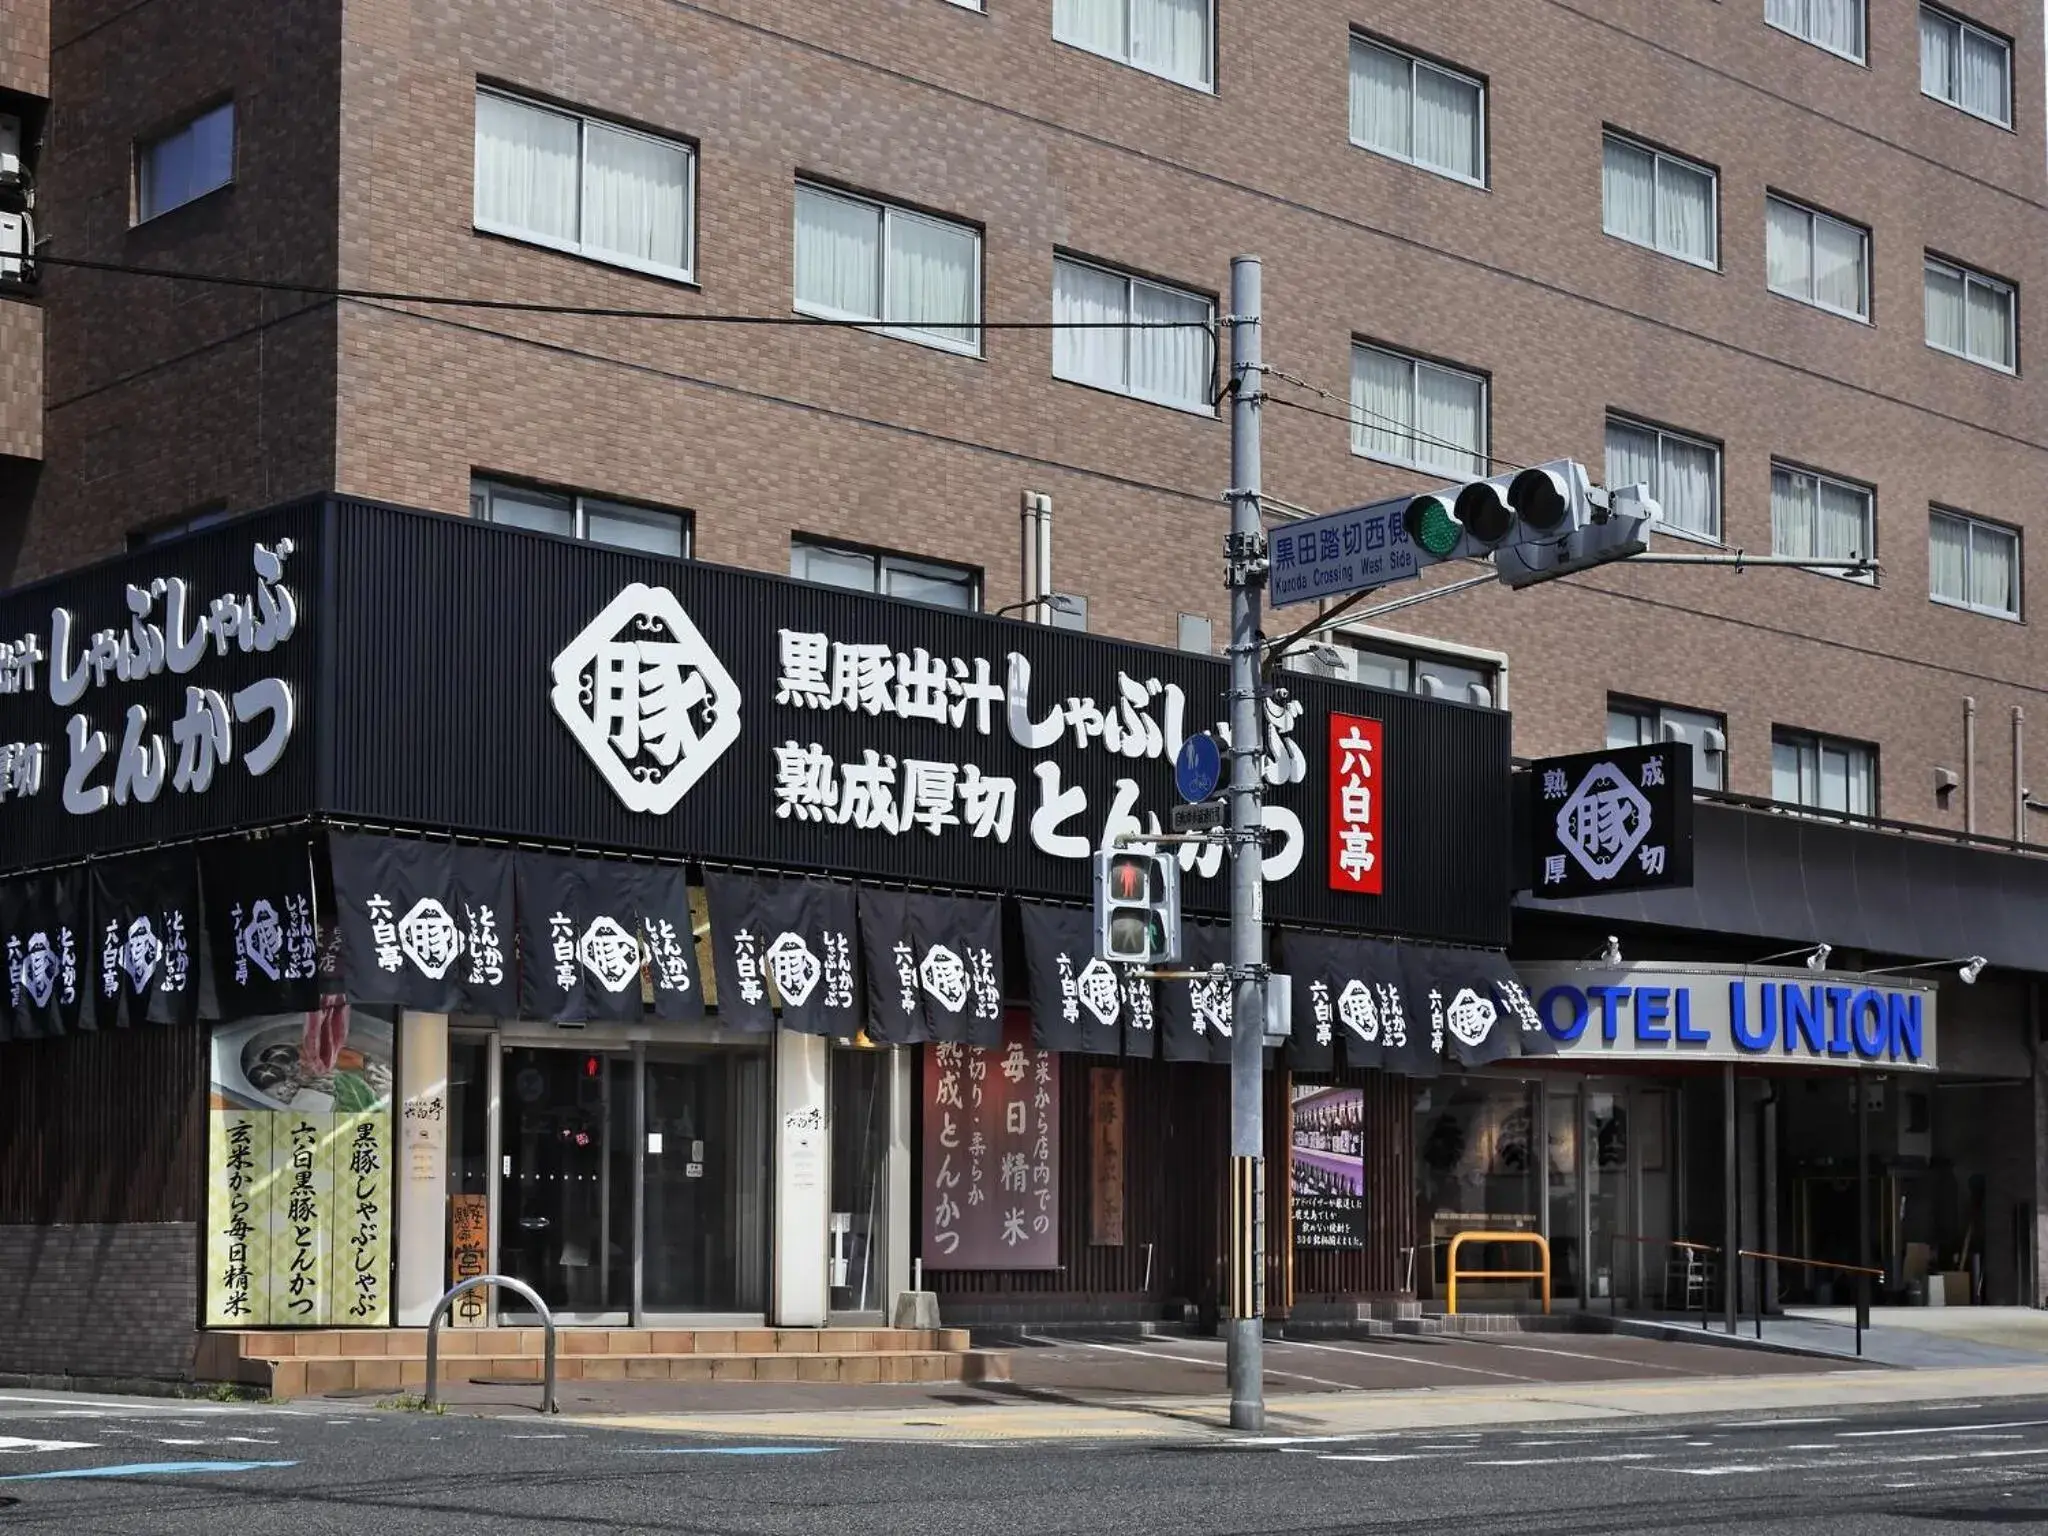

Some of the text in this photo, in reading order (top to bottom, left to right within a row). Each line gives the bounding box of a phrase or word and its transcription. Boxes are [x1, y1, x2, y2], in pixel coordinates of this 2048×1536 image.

[1275, 550, 1412, 595] Kuroda Crossing West Side
[1338, 725, 1375, 882] 六白亭
[297, 893, 316, 979] とんかつ
[366, 893, 404, 974] 六白亭
[479, 904, 503, 986] とんかつ
[549, 912, 577, 993] 六白亭
[659, 918, 690, 992] とんかつ
[734, 928, 764, 1006] 六白亭
[823, 930, 839, 1007] しゃぶしゃぶ
[837, 932, 853, 1009] とんかつ
[892, 940, 918, 1016] 六白亭
[980, 948, 1000, 1020] とんかつ
[1056, 952, 1079, 1024] 六白亭
[1310, 980, 1333, 1047] 六白亭
[1388, 982, 1407, 1048] とんかつ
[1428, 988, 1444, 1054] 六白亭
[1512, 981, 1923, 1060] OTEL UNION
[935, 1041, 963, 1255] 熟成とんかつ
[1000, 1041, 1030, 1247] 毎日精米
[223, 1120, 255, 1317] 玄米から毎日精米
[288, 1121, 319, 1316] 六白黒豚とんかつ
